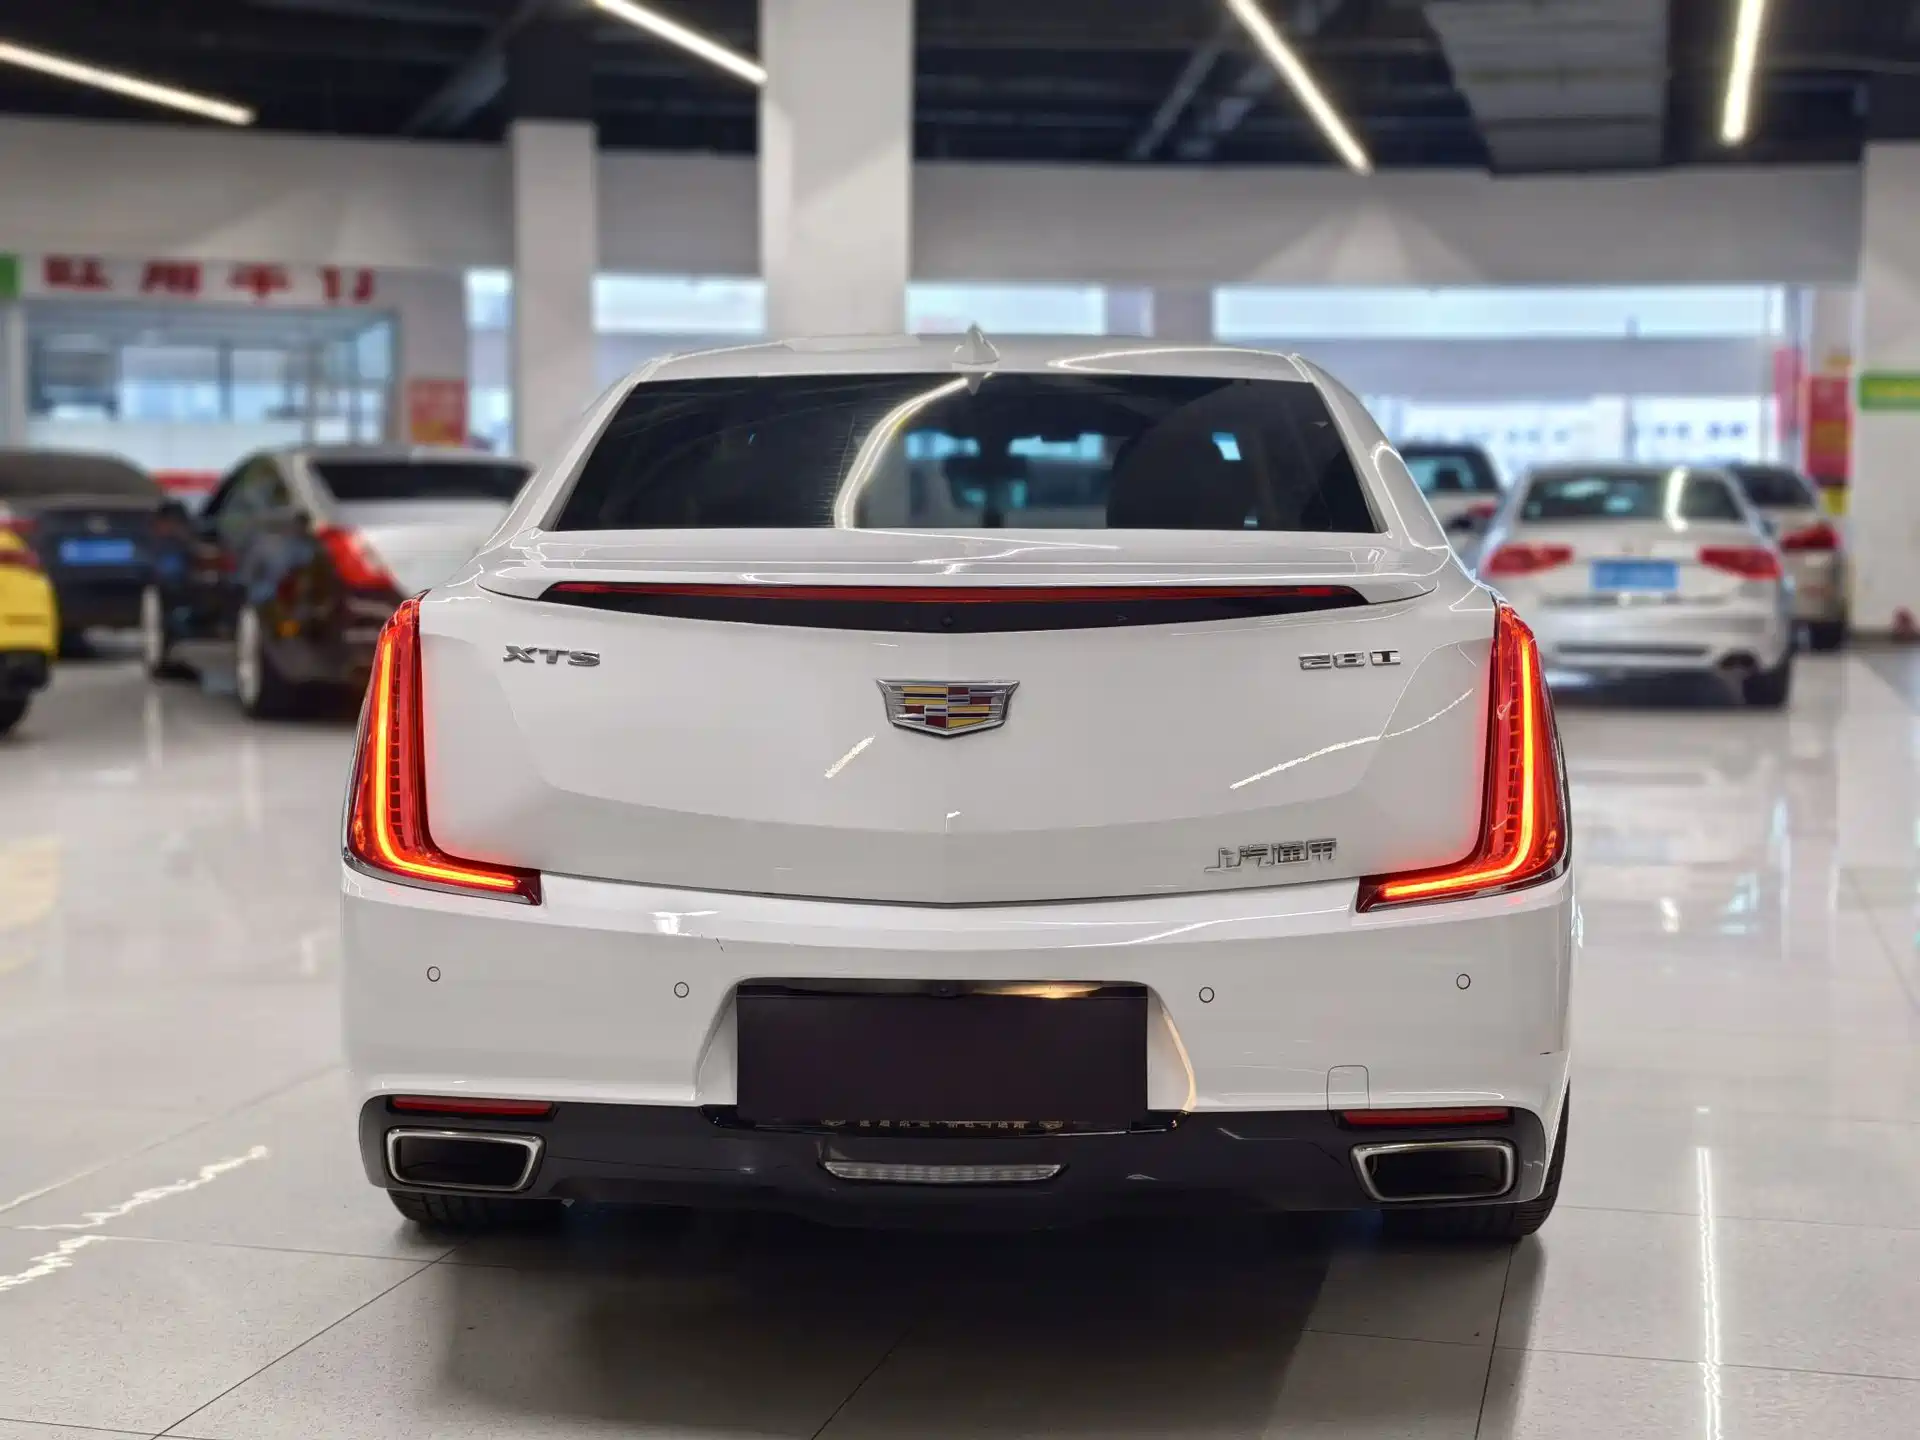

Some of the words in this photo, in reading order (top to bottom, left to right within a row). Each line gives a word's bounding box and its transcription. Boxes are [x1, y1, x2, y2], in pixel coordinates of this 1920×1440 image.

[502, 645, 601, 667] XTS
[1298, 649, 1401, 670] 28T
[1203, 838, 1337, 872] 上汽通用
